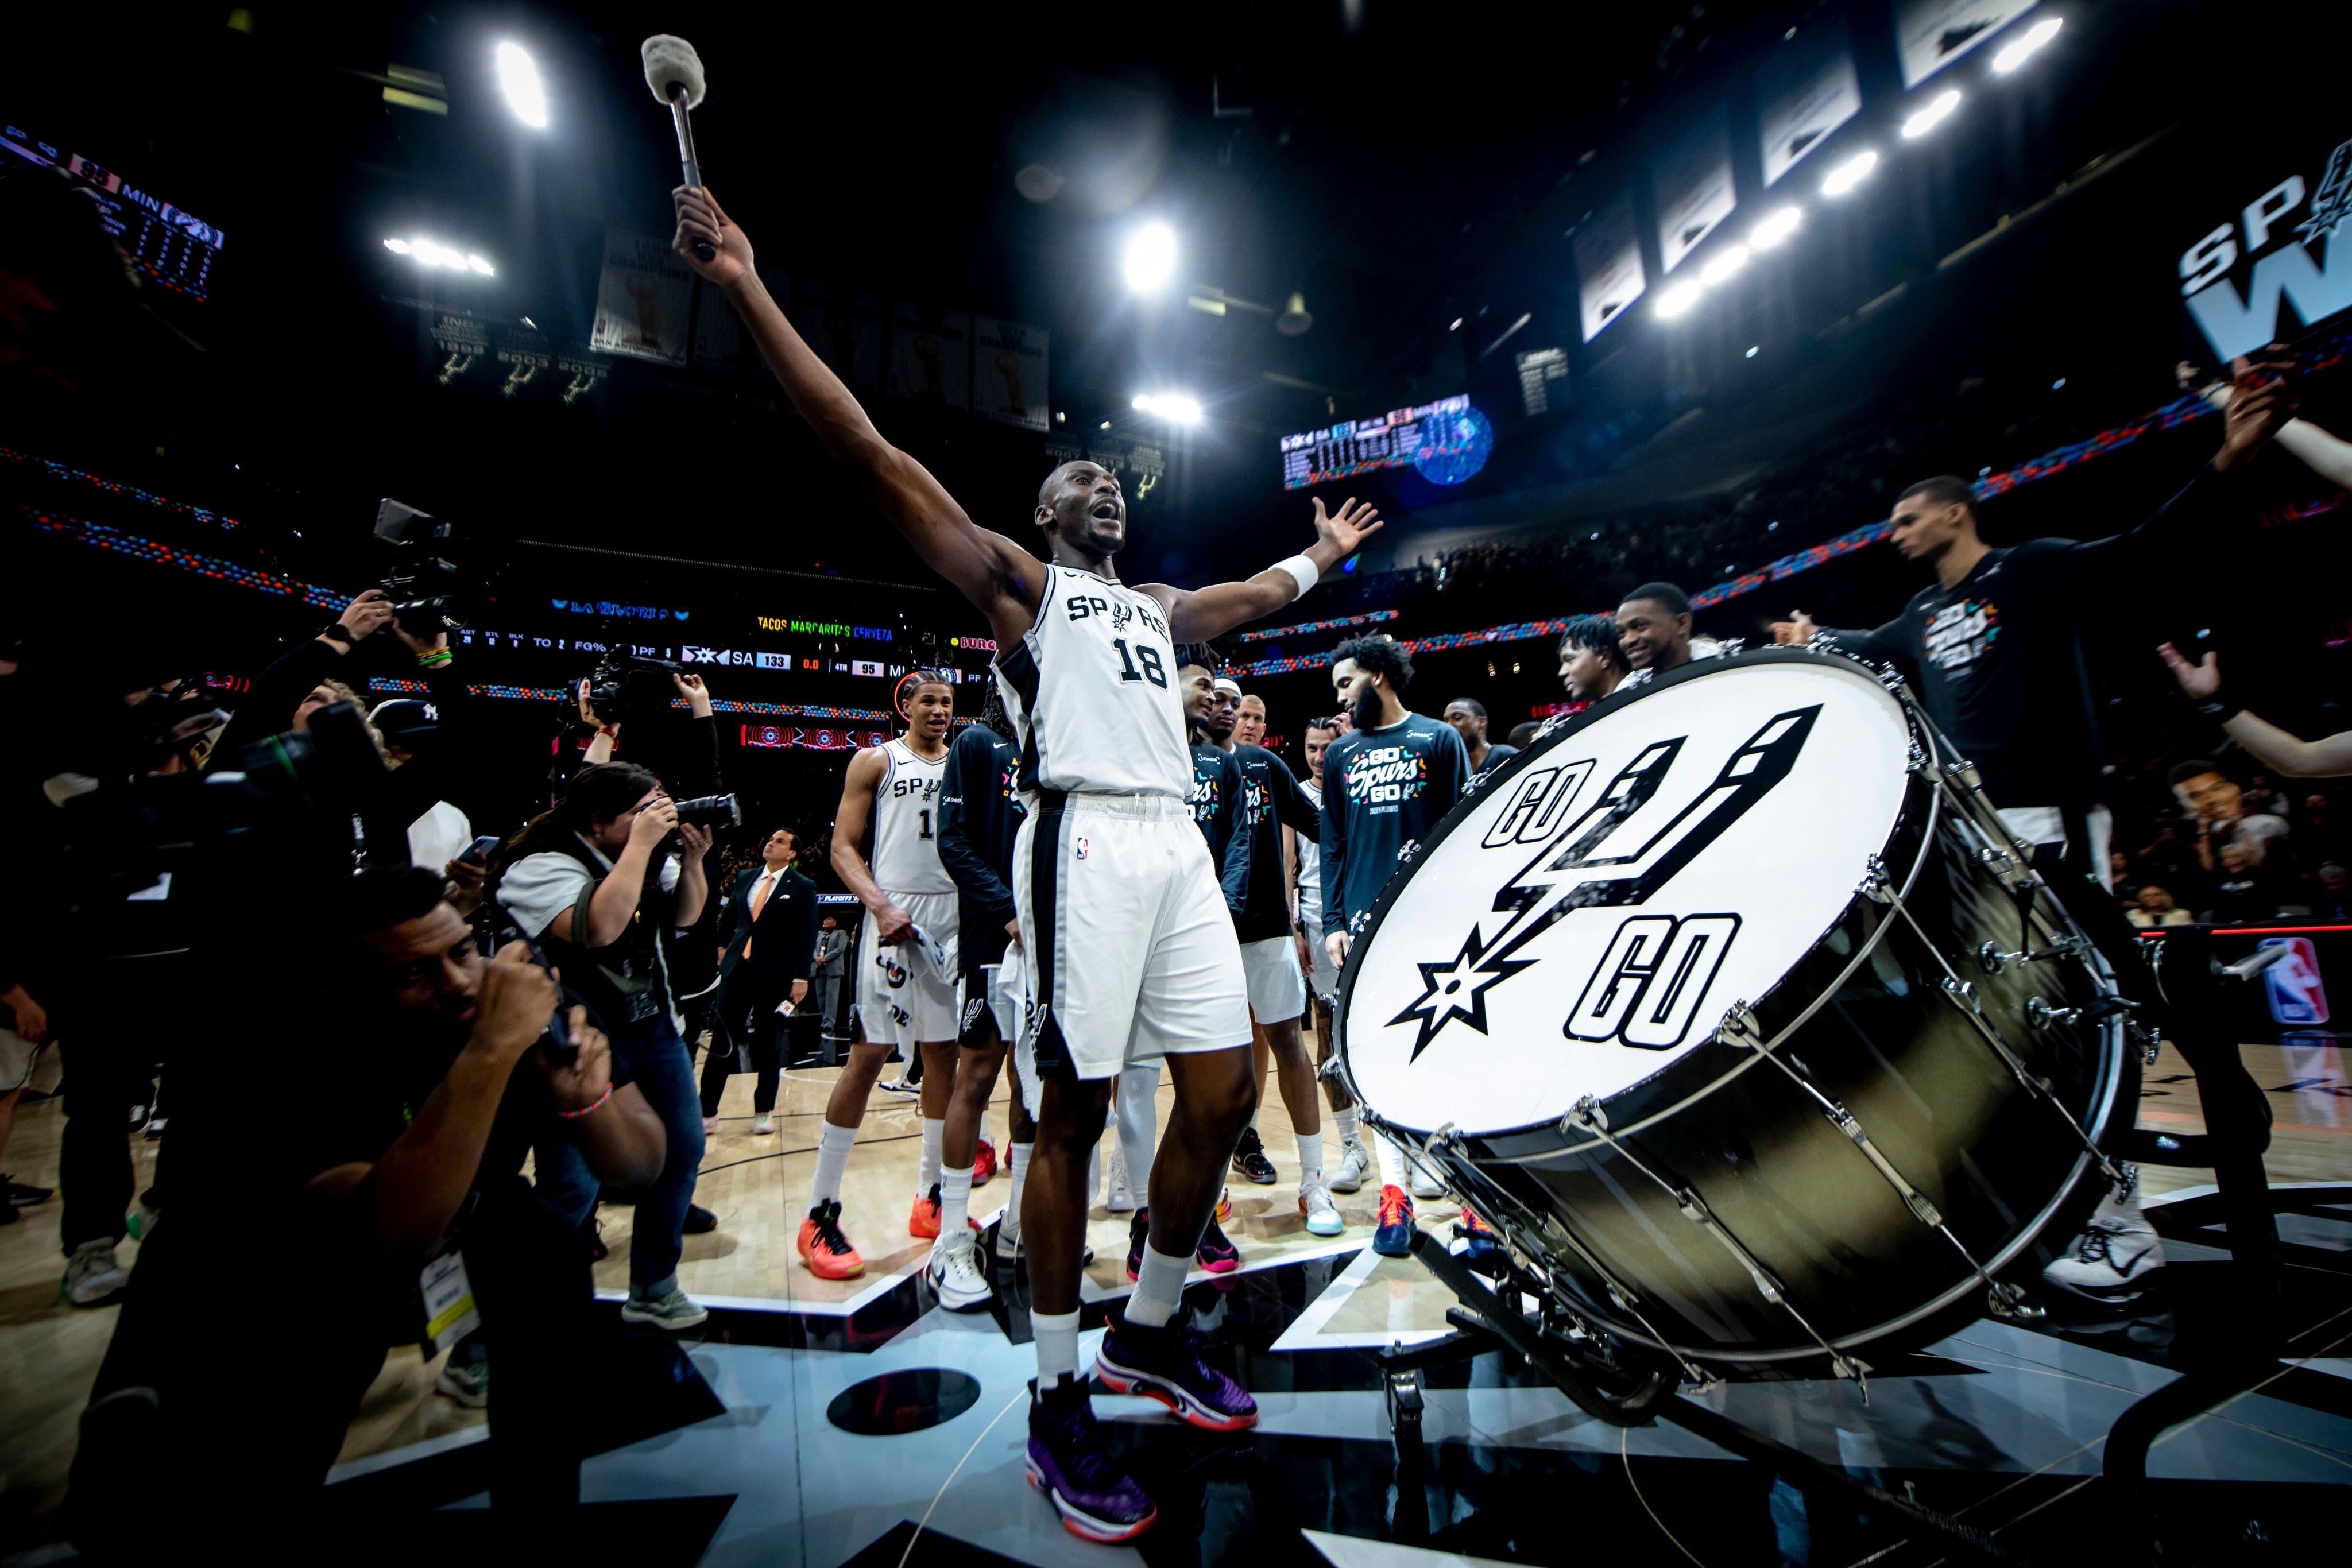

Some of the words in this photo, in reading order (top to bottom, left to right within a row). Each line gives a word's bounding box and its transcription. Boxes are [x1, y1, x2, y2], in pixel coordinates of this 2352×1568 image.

[80, 160, 110, 187] 95
[122, 183, 160, 212] MIN
[757, 616, 787, 631] TACOS
[533, 637, 551, 648] TO
[558, 639, 565, 650] 2
[575, 641, 606, 652] FG%
[639, 646, 656, 656] PF
[732, 651, 754, 666] SA
[764, 655, 784, 667] 133
[803, 658, 819, 670] 0.0
[835, 663, 848, 672] 4TH
[862, 664, 876, 675] 95
[968, 674, 981, 683] PF
[960, 637, 997, 651] BURG
[1111, 636, 1168, 692] 18
[1369, 747, 1400, 766] GO
[1349, 758, 1418, 797] Spurs
[1370, 784, 1401, 803] GO
[1482, 758, 1596, 849] GO
[919, 808, 938, 841] 1
[1563, 913, 1742, 1051] GO
